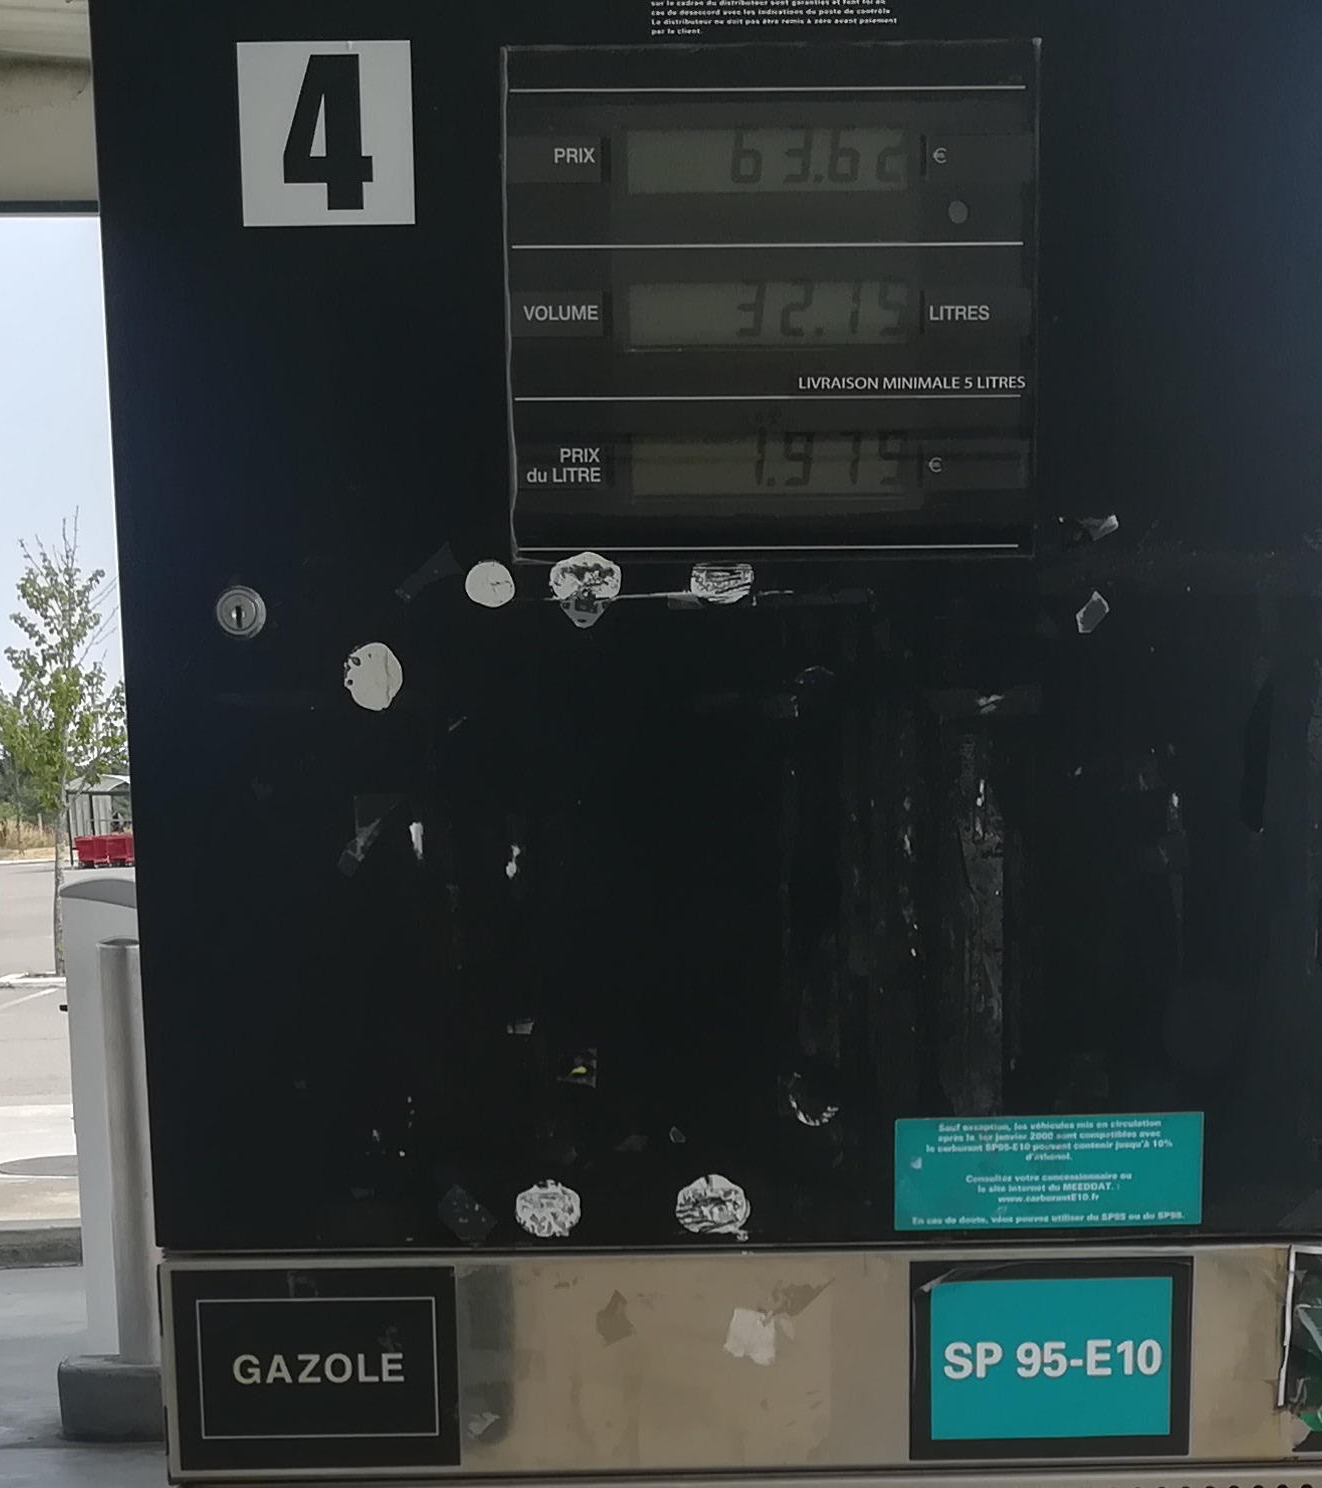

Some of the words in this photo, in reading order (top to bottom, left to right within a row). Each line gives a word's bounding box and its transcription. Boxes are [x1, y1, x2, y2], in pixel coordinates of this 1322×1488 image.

[284, 54, 373, 210] 4
[553, 148, 596, 165] PRIX
[932, 147, 949, 165] €
[522, 305, 599, 322] VOLUME
[928, 304, 991, 322] LITRES
[797, 376, 879, 391] LIVRAISON
[882, 376, 961, 390] MINIMALE
[963, 376, 973, 390] 5
[976, 375, 1026, 390] LITRES
[559, 447, 601, 464] PRIX
[927, 456, 944, 474] €
[526, 467, 548, 484] du
[552, 467, 602, 484] LITRE
[938, 1123, 961, 1132] Sauf
[1076, 1121, 1094, 1129] mis
[1096, 1121, 1108, 1129] en
[1110, 1119, 1162, 1128] circulation
[994, 1132, 1028, 1143] janvier
[1079, 1130, 1137, 1141] compatibles
[1139, 1129, 1162, 1138] avec
[937, 1144, 983, 1153] carburant
[1073, 1141, 1113, 1150] contenir
[1152, 1139, 1174, 1148] 10%
[965, 1174, 1012, 1183] Consultez
[1014, 1174, 1039, 1182] votre
[1041, 1172, 1118, 1181] concessionnaire
[988, 1184, 1006, 1193] site
[1008, 1184, 1046, 1192] internet
[1048, 1183, 1061, 1191] du
[997, 1193, 1100, 1203] www.carburantE10.fr
[911, 1216, 925, 1225] En
[1051, 1214, 1084, 1222] utiliser
[1086, 1213, 1099, 1221] du
[1142, 1212, 1155, 1220] du
[943, 1341, 1003, 1380] SP
[1016, 1338, 1163, 1379] 95-E10
[232, 1352, 405, 1385] GAZOLE
